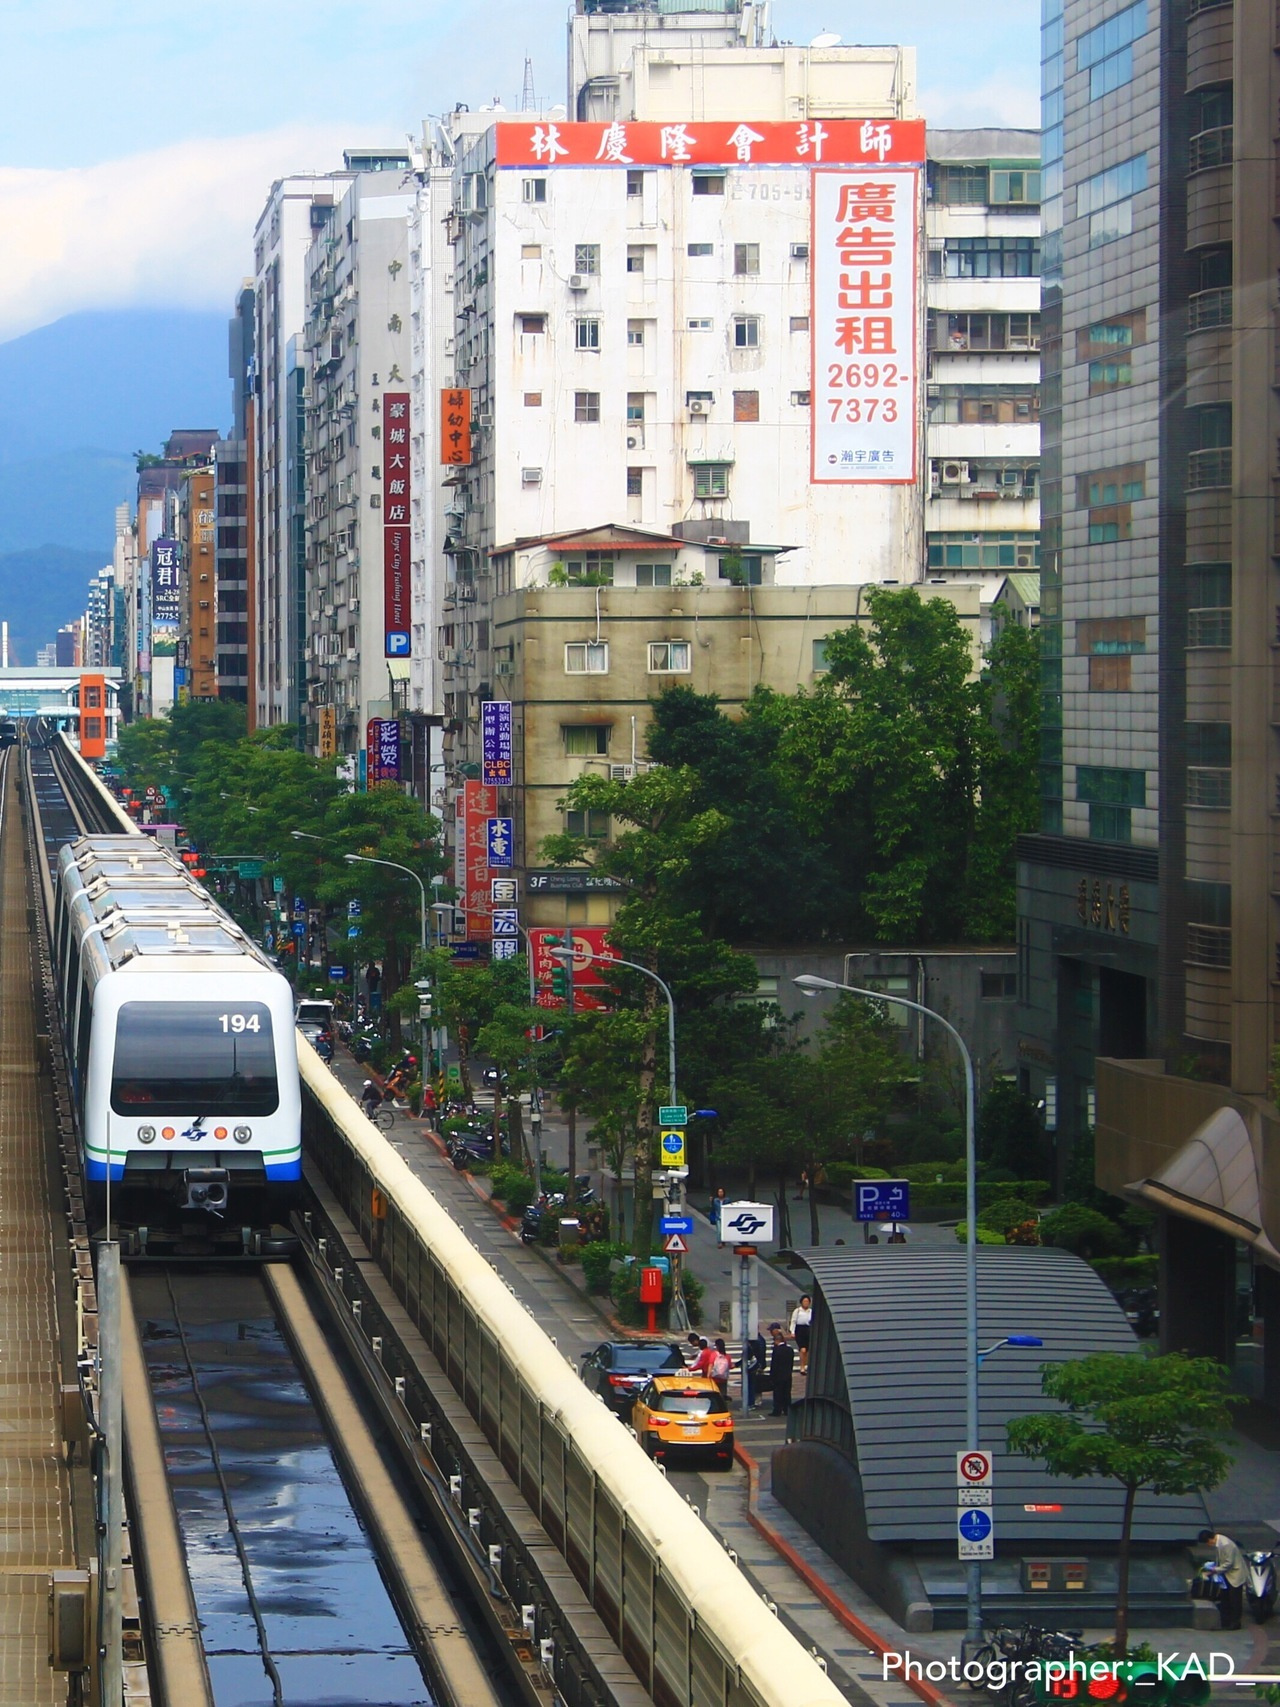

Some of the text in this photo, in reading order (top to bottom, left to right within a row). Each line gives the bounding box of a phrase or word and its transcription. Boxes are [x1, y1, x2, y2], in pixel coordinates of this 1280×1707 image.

[529, 120, 892, 164] 林慶隆會計師
[835, 182, 897, 356] 廣告出租
[828, 363, 909, 388] 2692-
[827, 398, 898, 423] 7373
[448, 391, 464, 463] 婦幼中心
[389, 402, 406, 521] 豪城大飯店
[156, 547, 174, 586] 冠君
[390, 634, 407, 653] P
[484, 760, 511, 769] CLBC
[490, 820, 510, 856] 水電
[530, 876, 548, 888] 3F
[219, 1014, 261, 1033] 194
[860, 1186, 880, 1212] P
